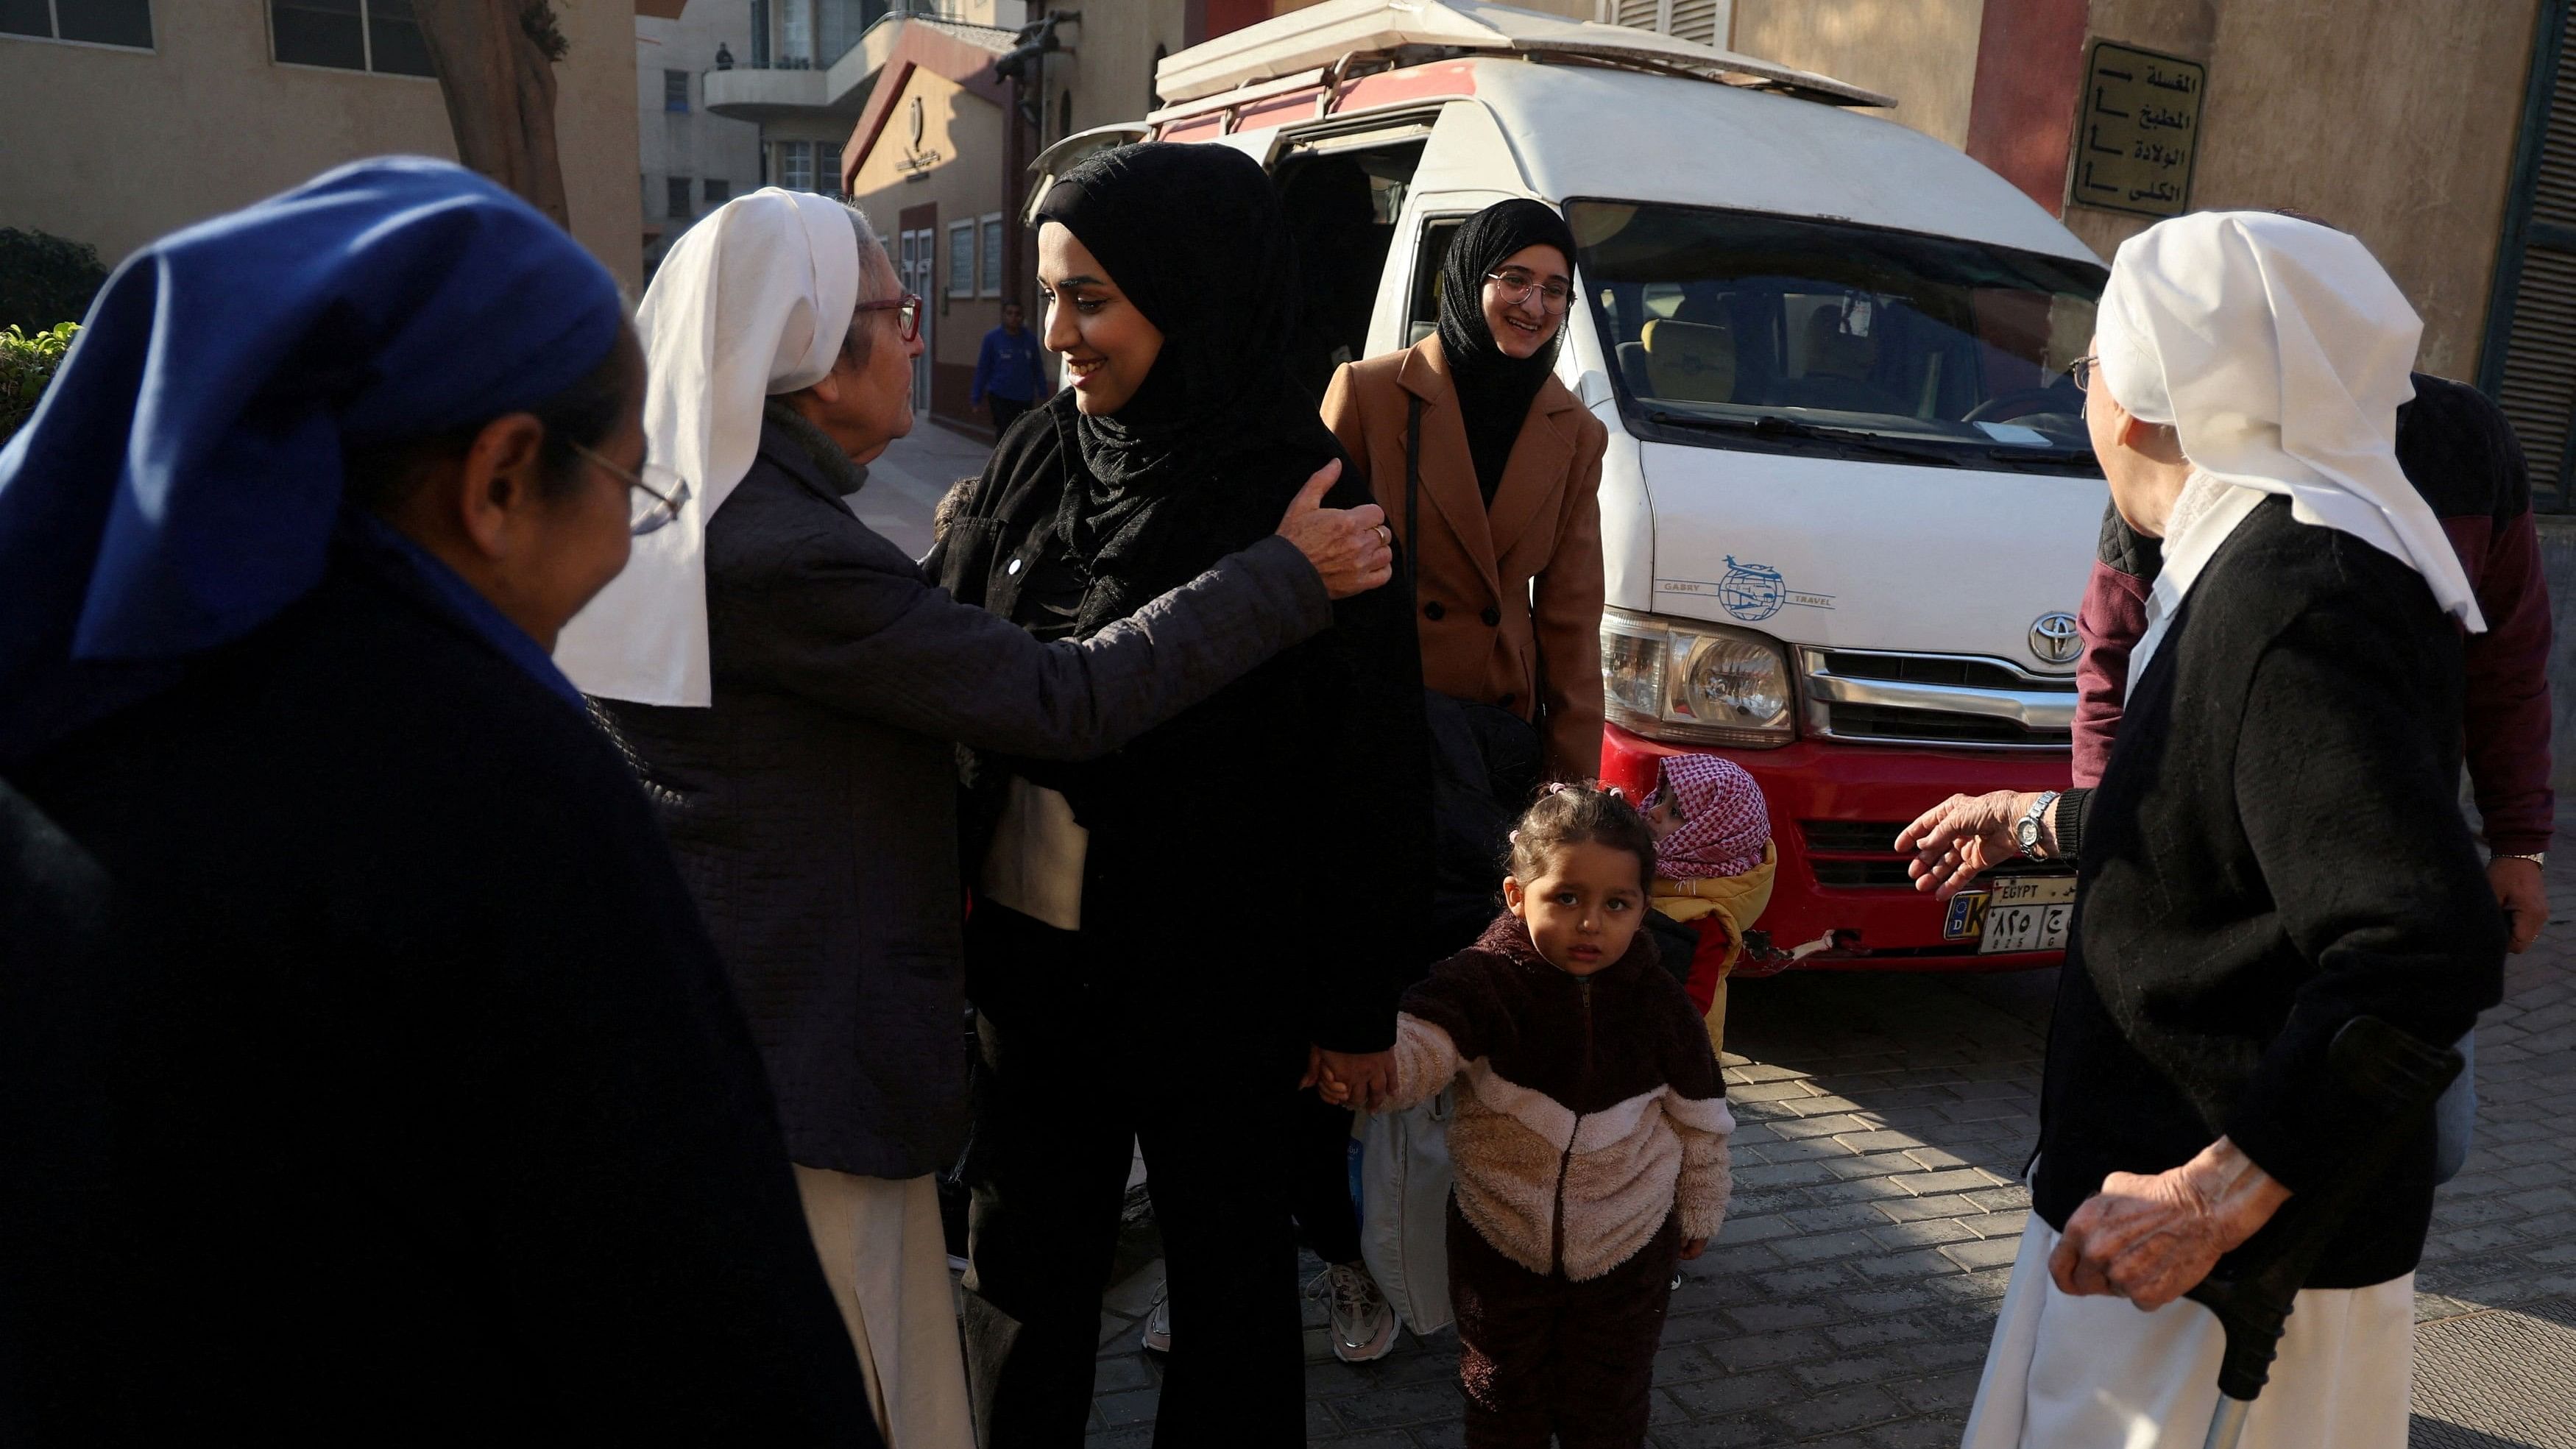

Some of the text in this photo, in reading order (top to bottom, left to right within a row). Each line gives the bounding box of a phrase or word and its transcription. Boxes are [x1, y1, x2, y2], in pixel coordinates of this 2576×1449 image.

[2134, 140, 2185, 169] الولادة
[1664, 583, 1832, 606] GABRY TRAVEL
[2002, 885, 2039, 899] EGYPT
[1953, 919, 1963, 930] D
